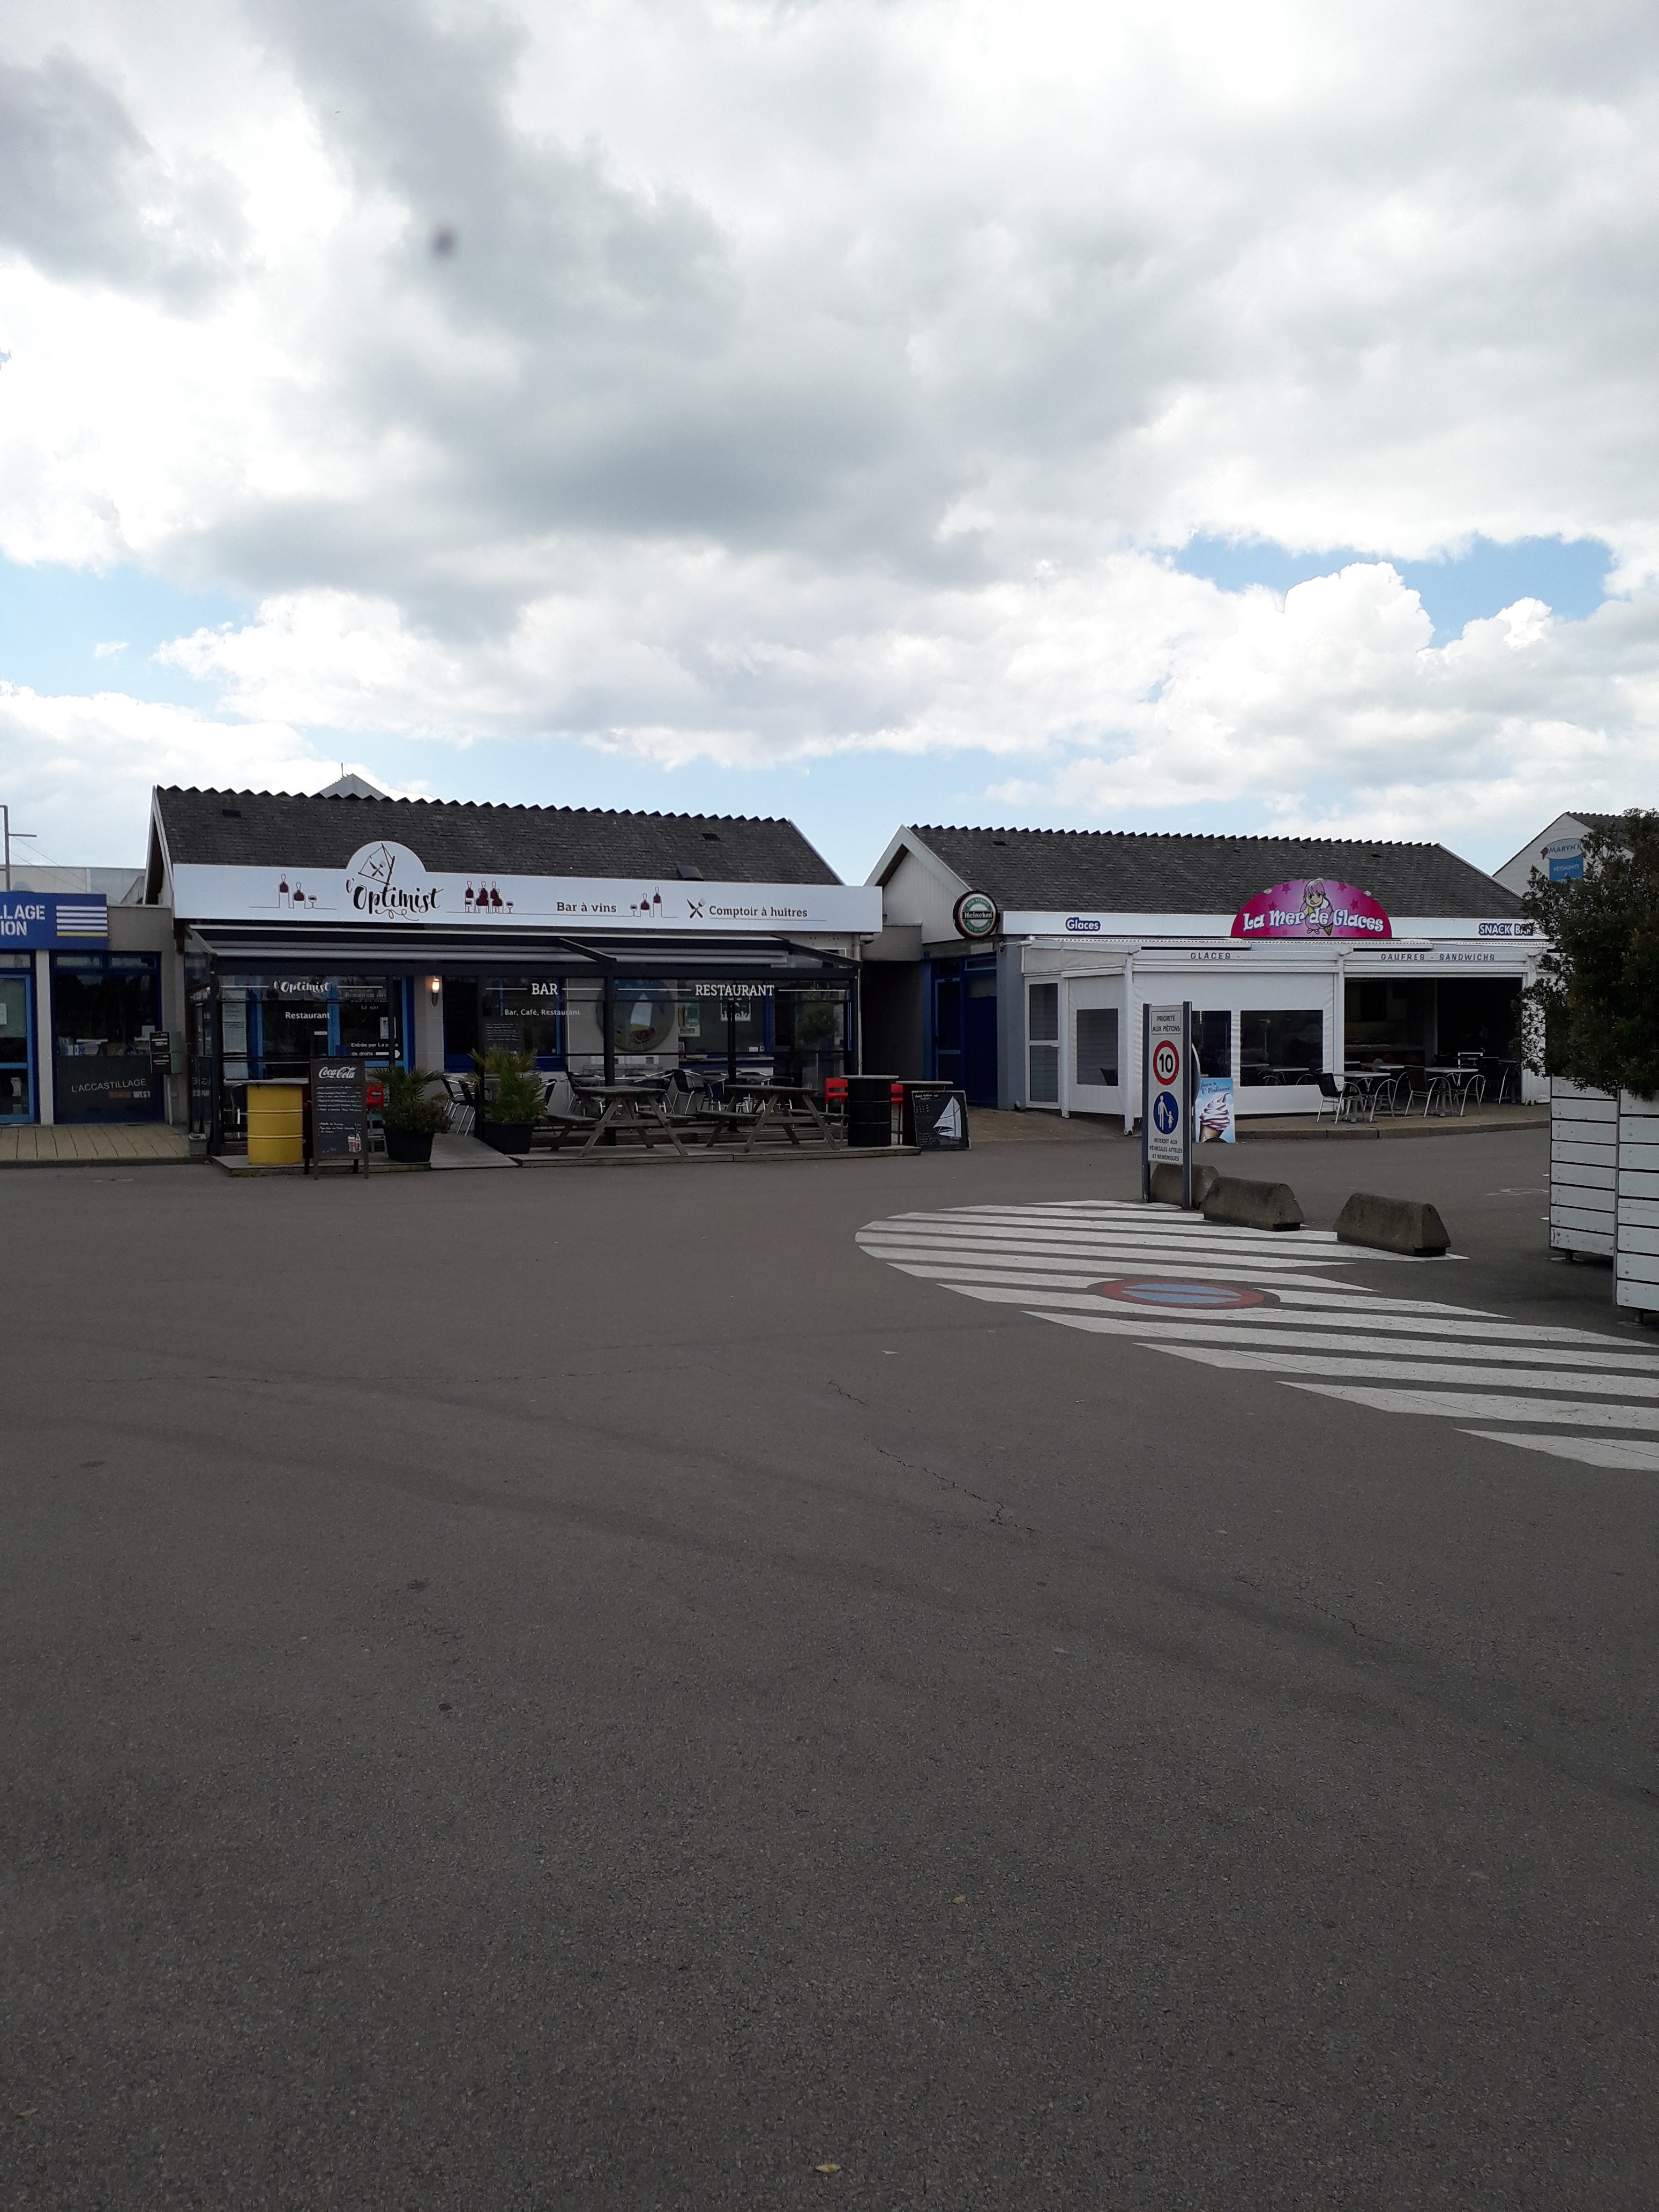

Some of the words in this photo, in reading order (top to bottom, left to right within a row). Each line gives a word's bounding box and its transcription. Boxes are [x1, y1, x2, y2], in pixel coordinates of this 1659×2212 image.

[0, 904, 46, 920] LAGE
[556, 901, 577, 912] Bar
[581, 901, 587, 912] à
[591, 902, 617, 913] vins
[709, 906, 758, 918] Comptoir
[761, 906, 768, 917] à
[1067, 918, 1100, 931] Glaces
[1243, 913, 1265, 931] La
[1269, 909, 1306, 926] Mer
[1309, 909, 1328, 925] de
[1333, 909, 1385, 932] Glaces
[1479, 924, 1512, 935] SNACK
[1190, 952, 1231, 960] GLACES
[531, 983, 558, 996] BAR
[695, 984, 775, 997] RESTAURANT
[285, 1011, 331, 1019] Restaurant
[1159, 1053, 1174, 1073] 10
[71, 1078, 147, 1093] L'ACCASTILLAGE
